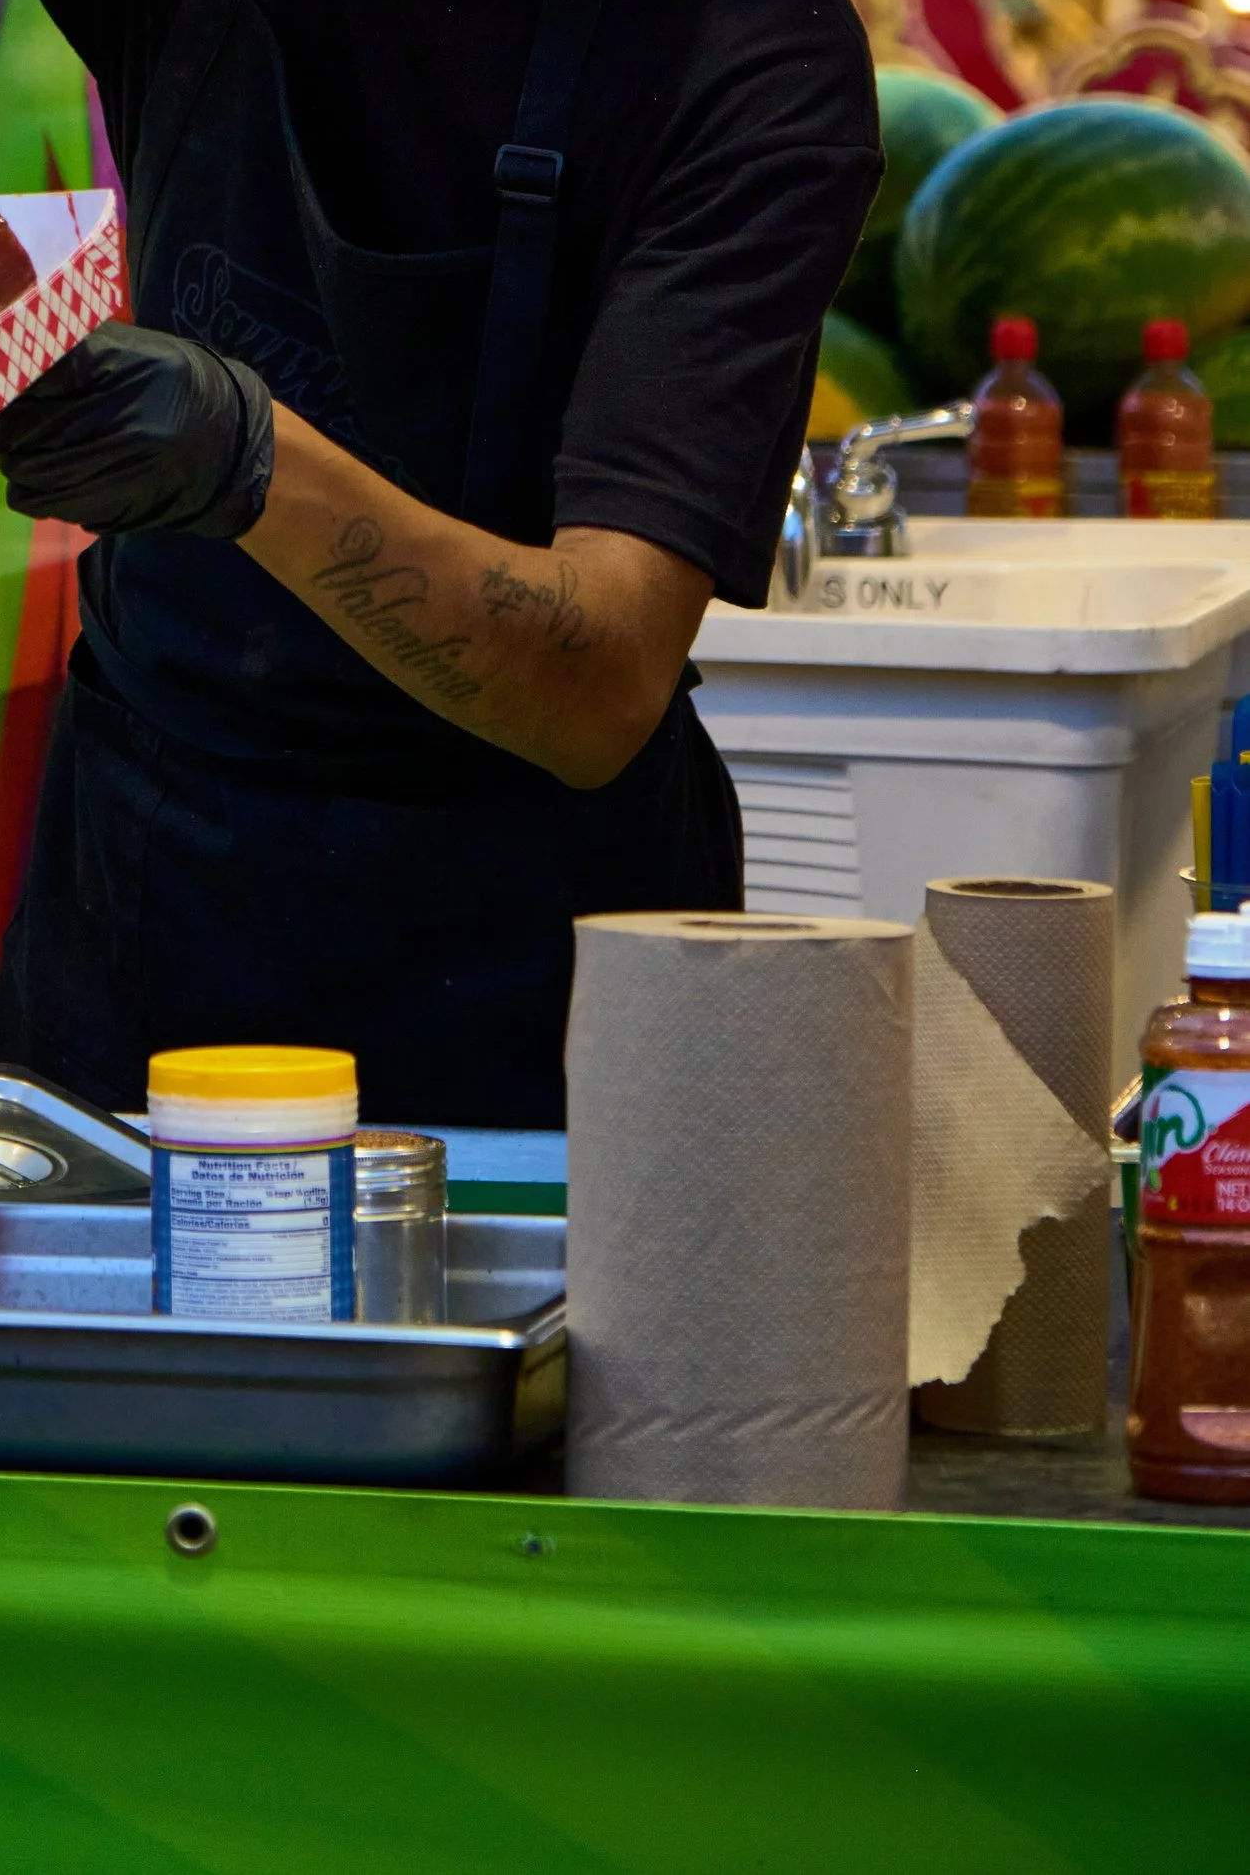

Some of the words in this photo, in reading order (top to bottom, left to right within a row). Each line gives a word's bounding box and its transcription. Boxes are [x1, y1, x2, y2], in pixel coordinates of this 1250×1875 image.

[857, 576, 950, 610] ONLY
[198, 1160, 252, 1172] Nutrition
[256, 1161, 291, 1172] Facts
[229, 1172, 244, 1181] de
[247, 1170, 305, 1181] Nutrición
[1216, 1180, 1248, 1198] NET
